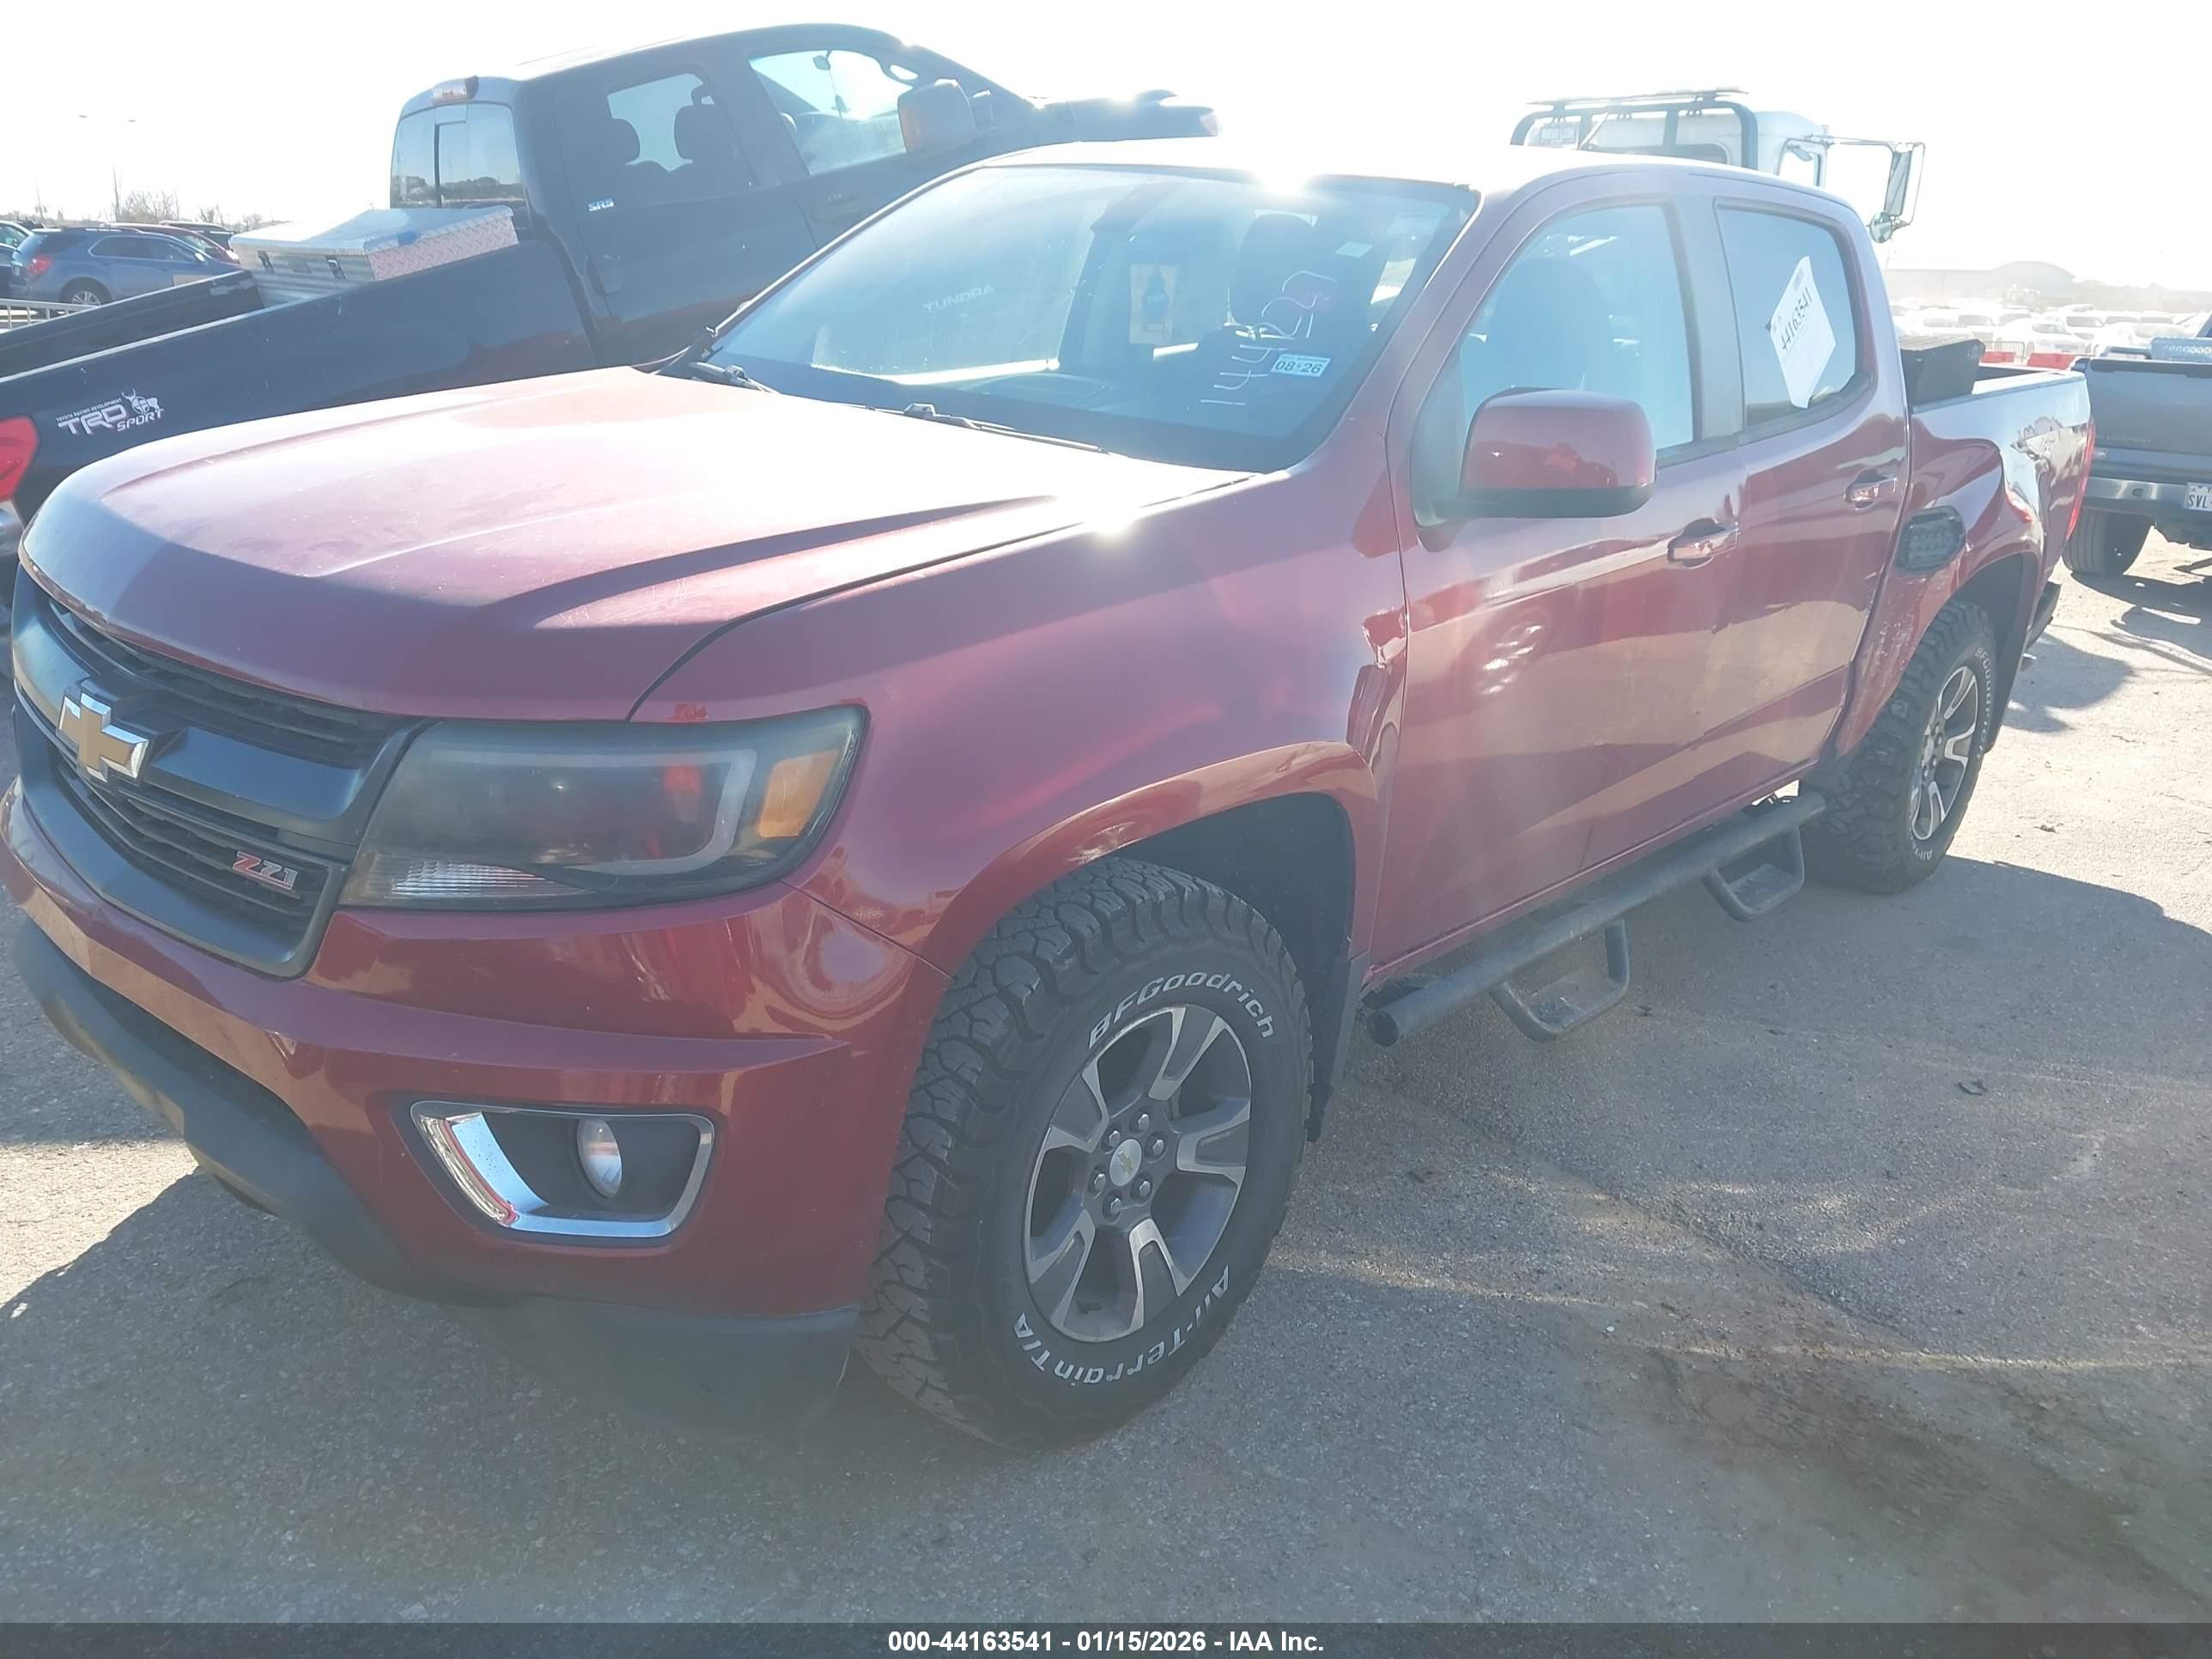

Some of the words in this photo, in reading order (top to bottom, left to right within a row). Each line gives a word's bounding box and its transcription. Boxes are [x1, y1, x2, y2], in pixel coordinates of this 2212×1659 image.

[922, 284, 995, 313] TUNDRA
[58, 404, 127, 434] TRD
[116, 408, 165, 432] SPORT
[232, 850, 299, 890] Z71
[1088, 971, 1274, 1050] BFGoodrich
